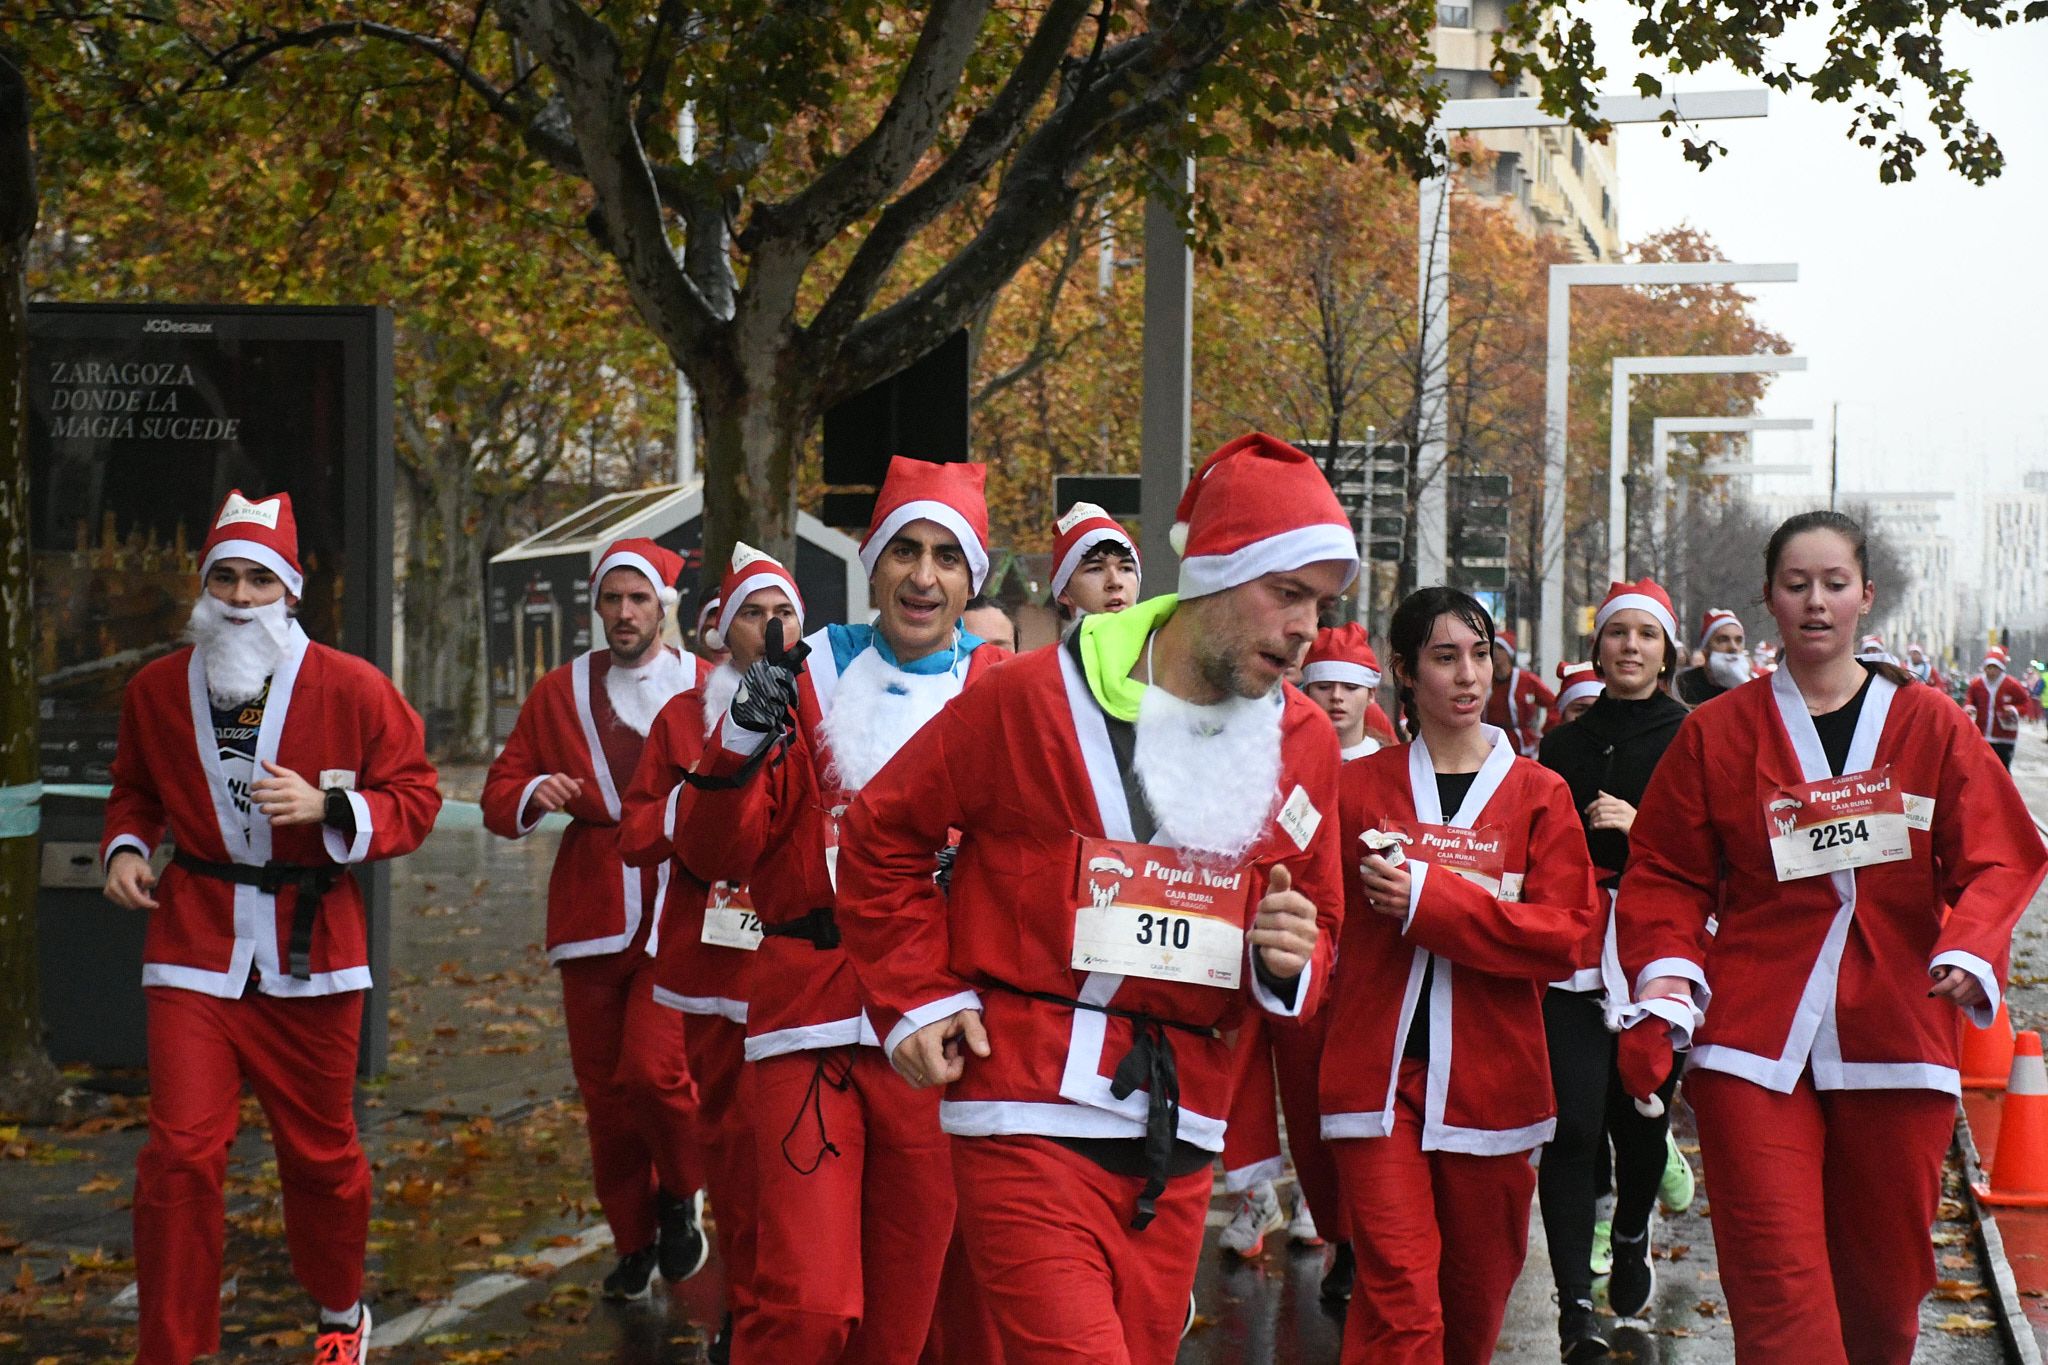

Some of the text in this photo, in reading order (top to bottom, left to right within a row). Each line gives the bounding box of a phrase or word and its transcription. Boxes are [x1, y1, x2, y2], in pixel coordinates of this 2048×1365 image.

[142, 319, 213, 333] JCDecaux
[51, 361, 196, 386] ZARAGOZA
[51, 389, 178, 412] DONDE LA
[51, 416, 241, 441] MAGIA SUCEDE
[1810, 777, 1891, 803] Papá Noel
[1832, 774, 1863, 785] CARRERA
[1831, 803, 1849, 811] CAJA
[1421, 833, 1499, 853] Papá Noel
[1447, 828, 1477, 837] CARRERA
[1809, 819, 1869, 851] 2254
[1437, 851, 1477, 862] CAJA RURAL
[1199, 868, 1242, 891] Noel
[1165, 889, 1214, 904] CAJA RURAL
[1135, 913, 1190, 950] 310
